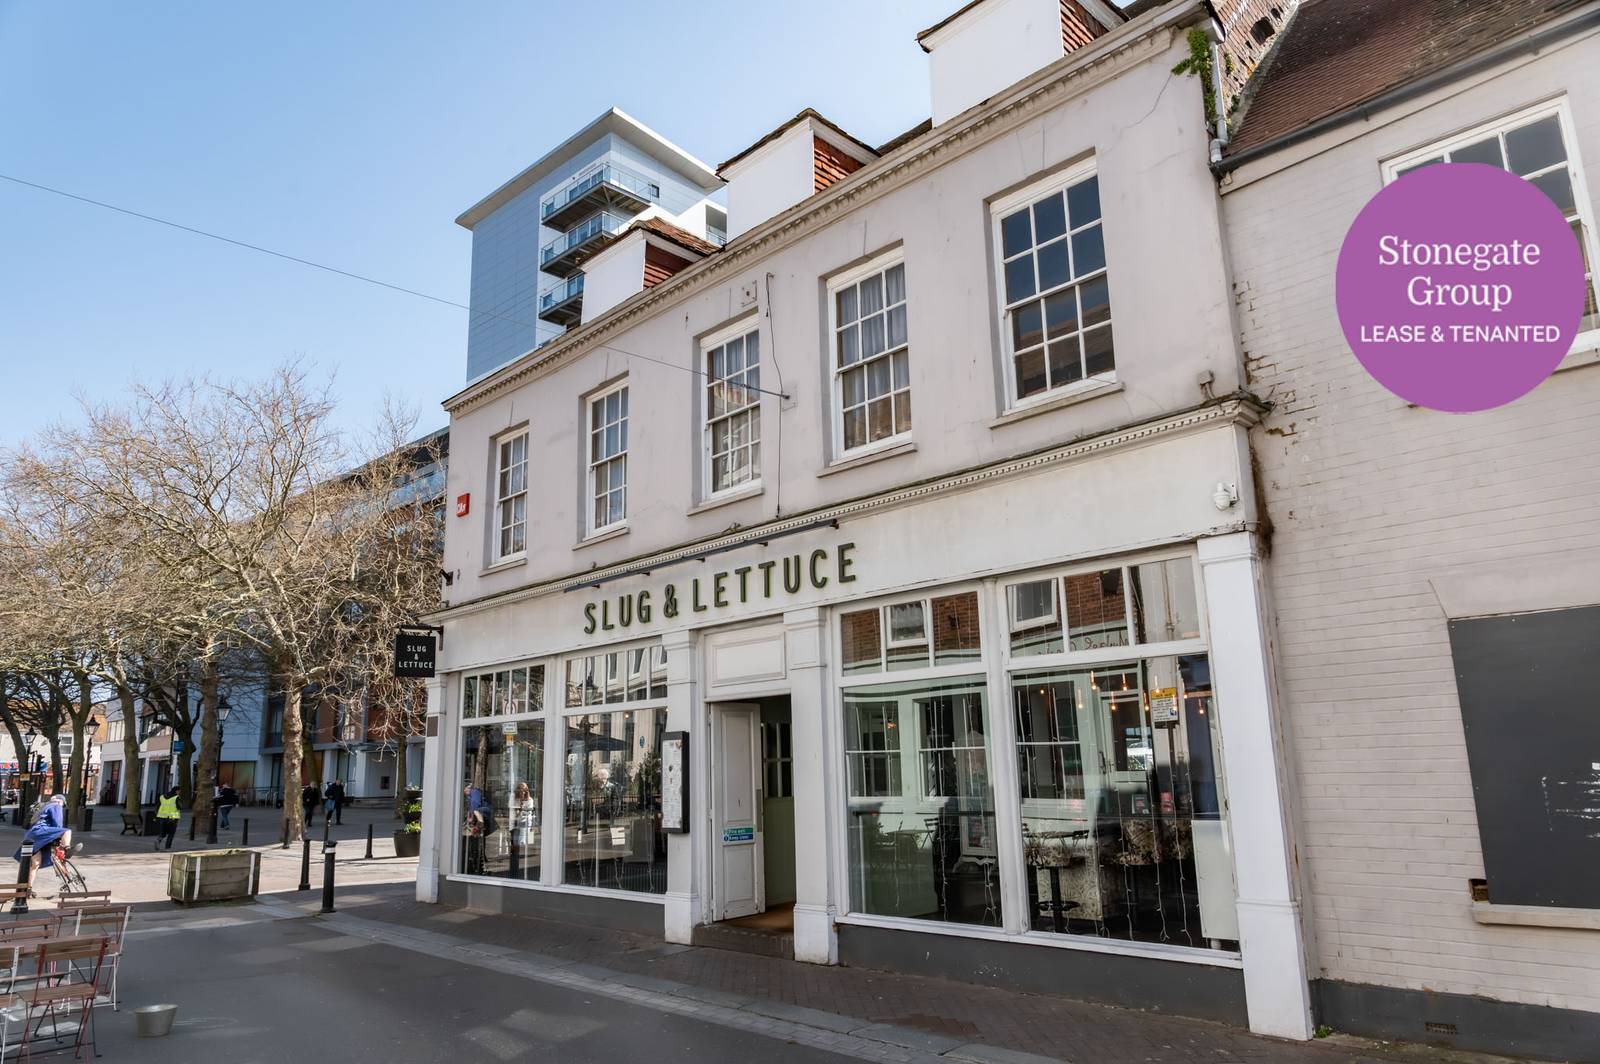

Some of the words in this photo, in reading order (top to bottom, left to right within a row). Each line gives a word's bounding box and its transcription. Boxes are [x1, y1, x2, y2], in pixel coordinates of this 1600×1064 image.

[583, 590, 651, 634] SLUG
[663, 584, 678, 618] &
[692, 542, 856, 612] LETTUCE
